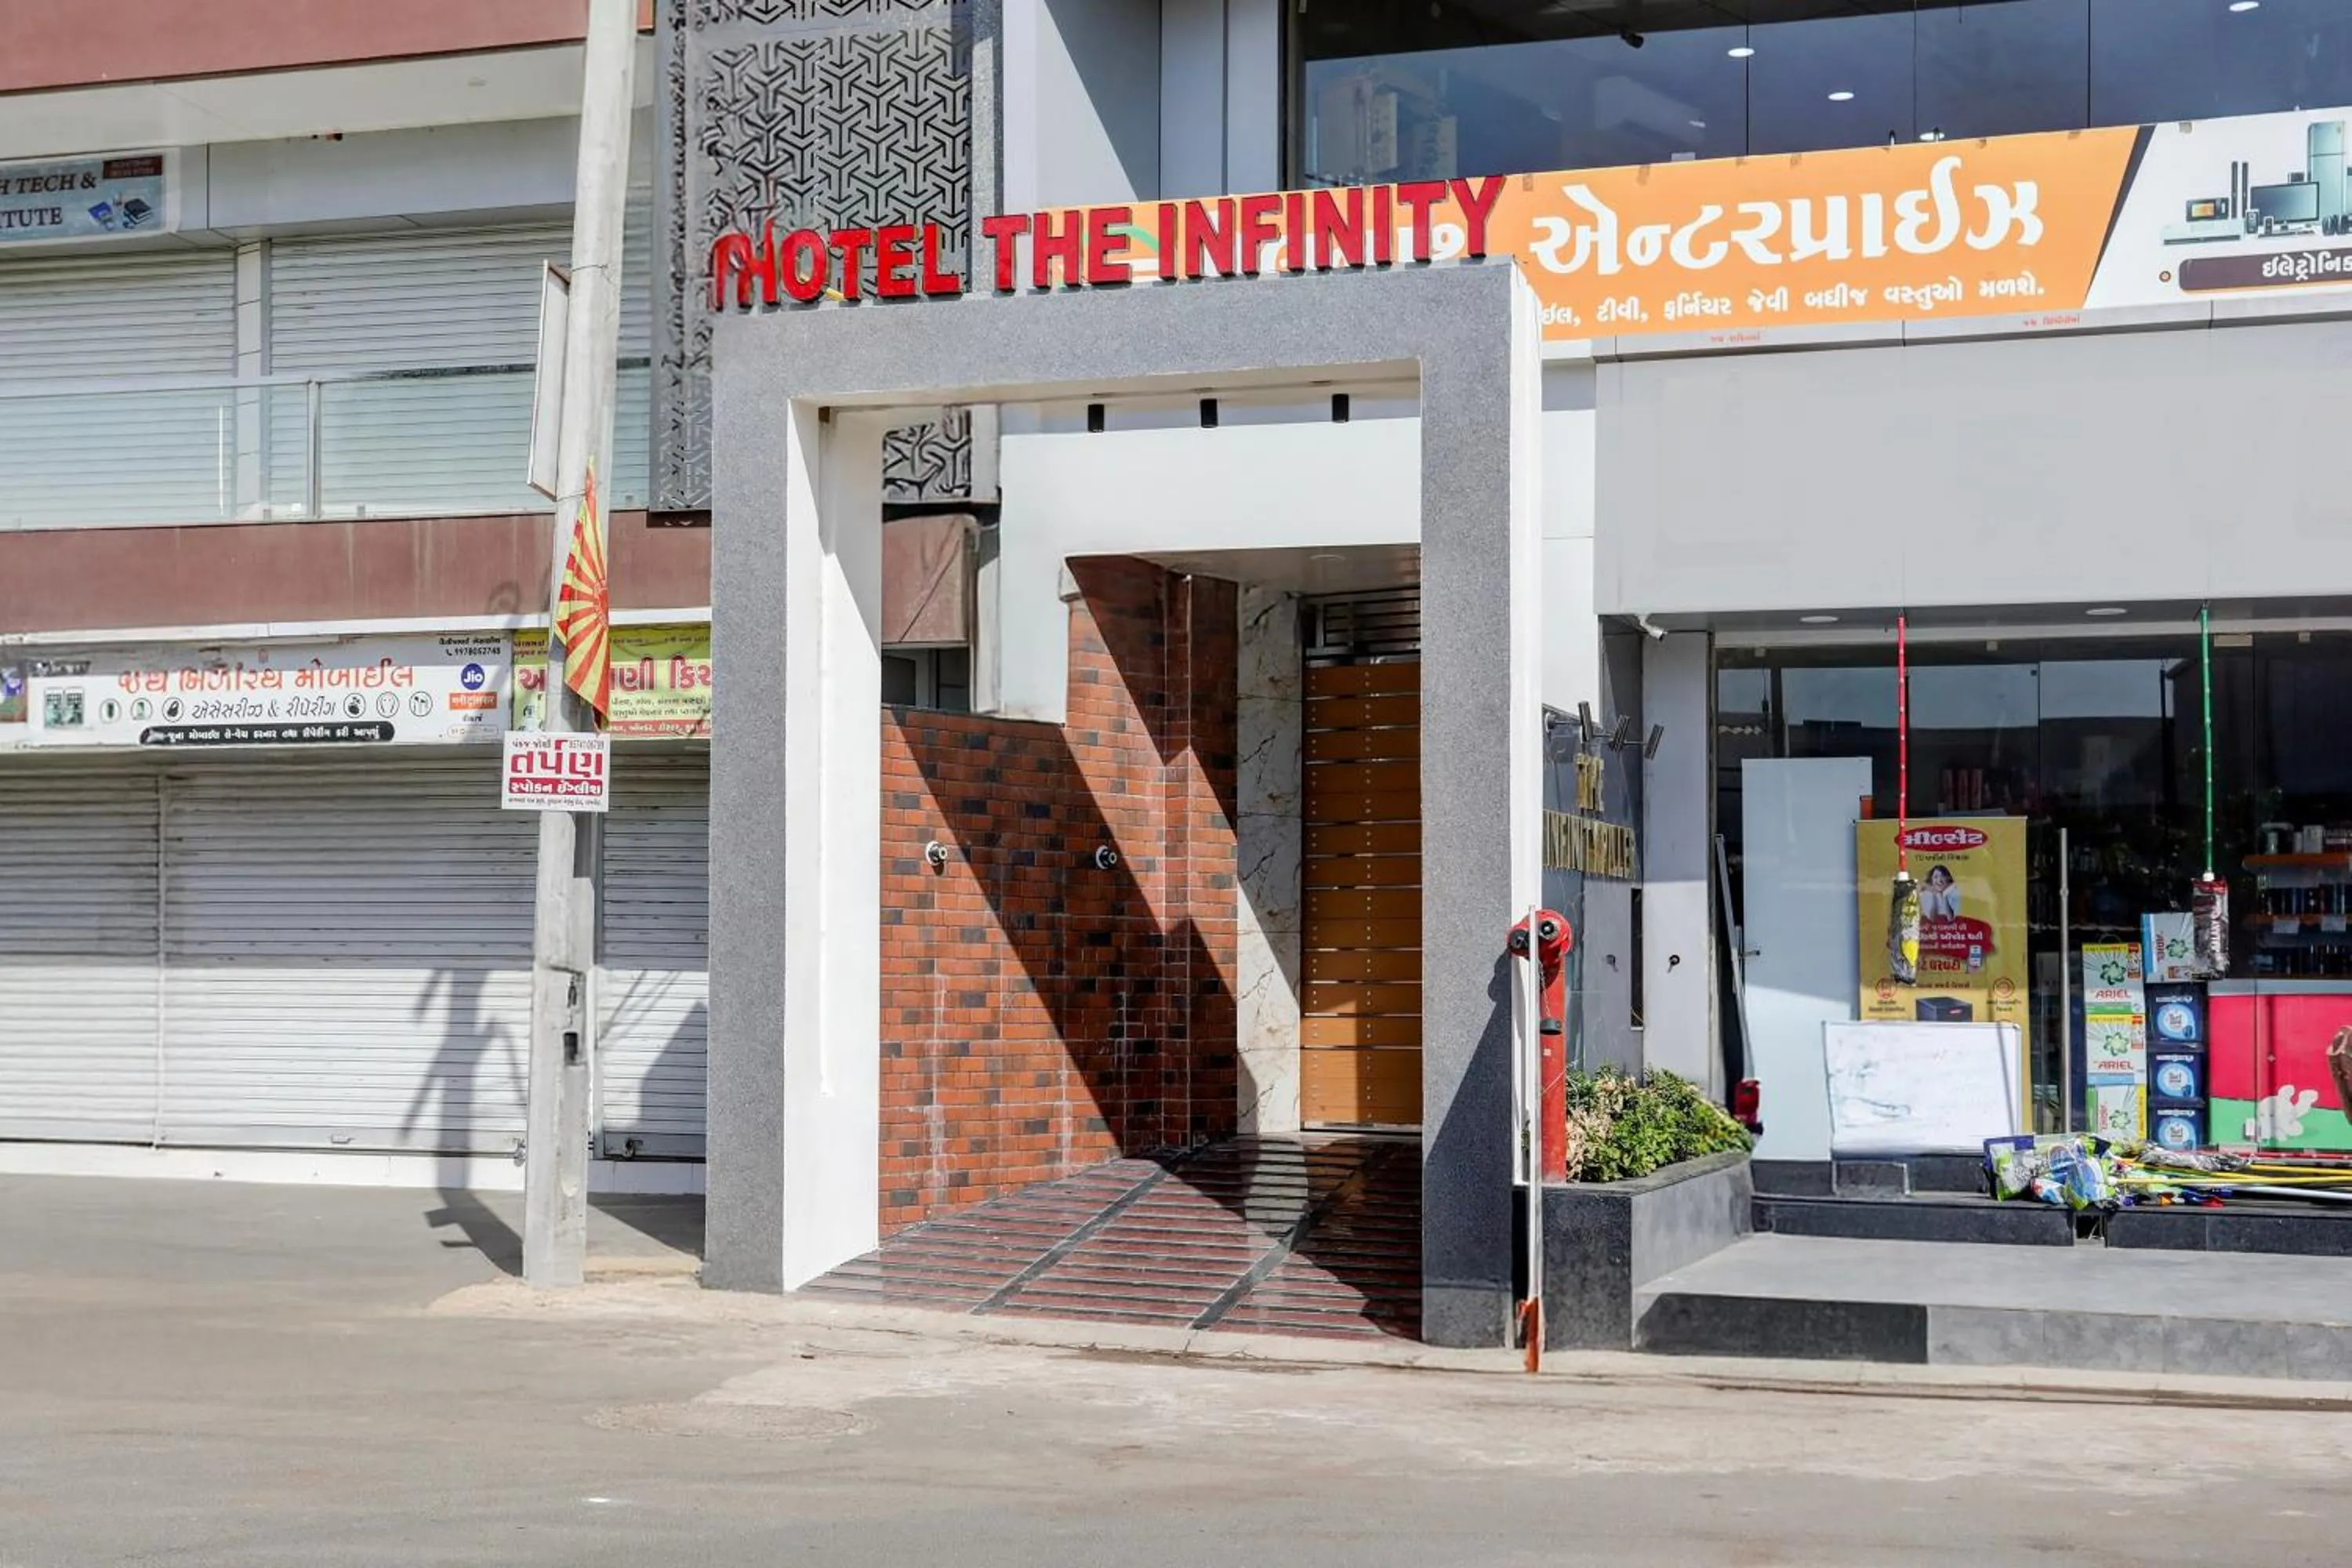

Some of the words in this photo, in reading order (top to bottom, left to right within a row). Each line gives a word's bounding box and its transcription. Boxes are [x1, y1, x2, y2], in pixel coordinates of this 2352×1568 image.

[16, 173, 77, 194] TECH
[80, 172, 97, 189] &
[0, 207, 63, 228] TUTE
[982, 206, 1132, 294] THE
[1159, 174, 1507, 282] INFINITY
[463, 670, 484, 684] Jio
[510, 739, 603, 778] તર્પણ
[2095, 989, 2132, 1000] ARIEL
[2098, 1060, 2134, 1070] ARIEL
